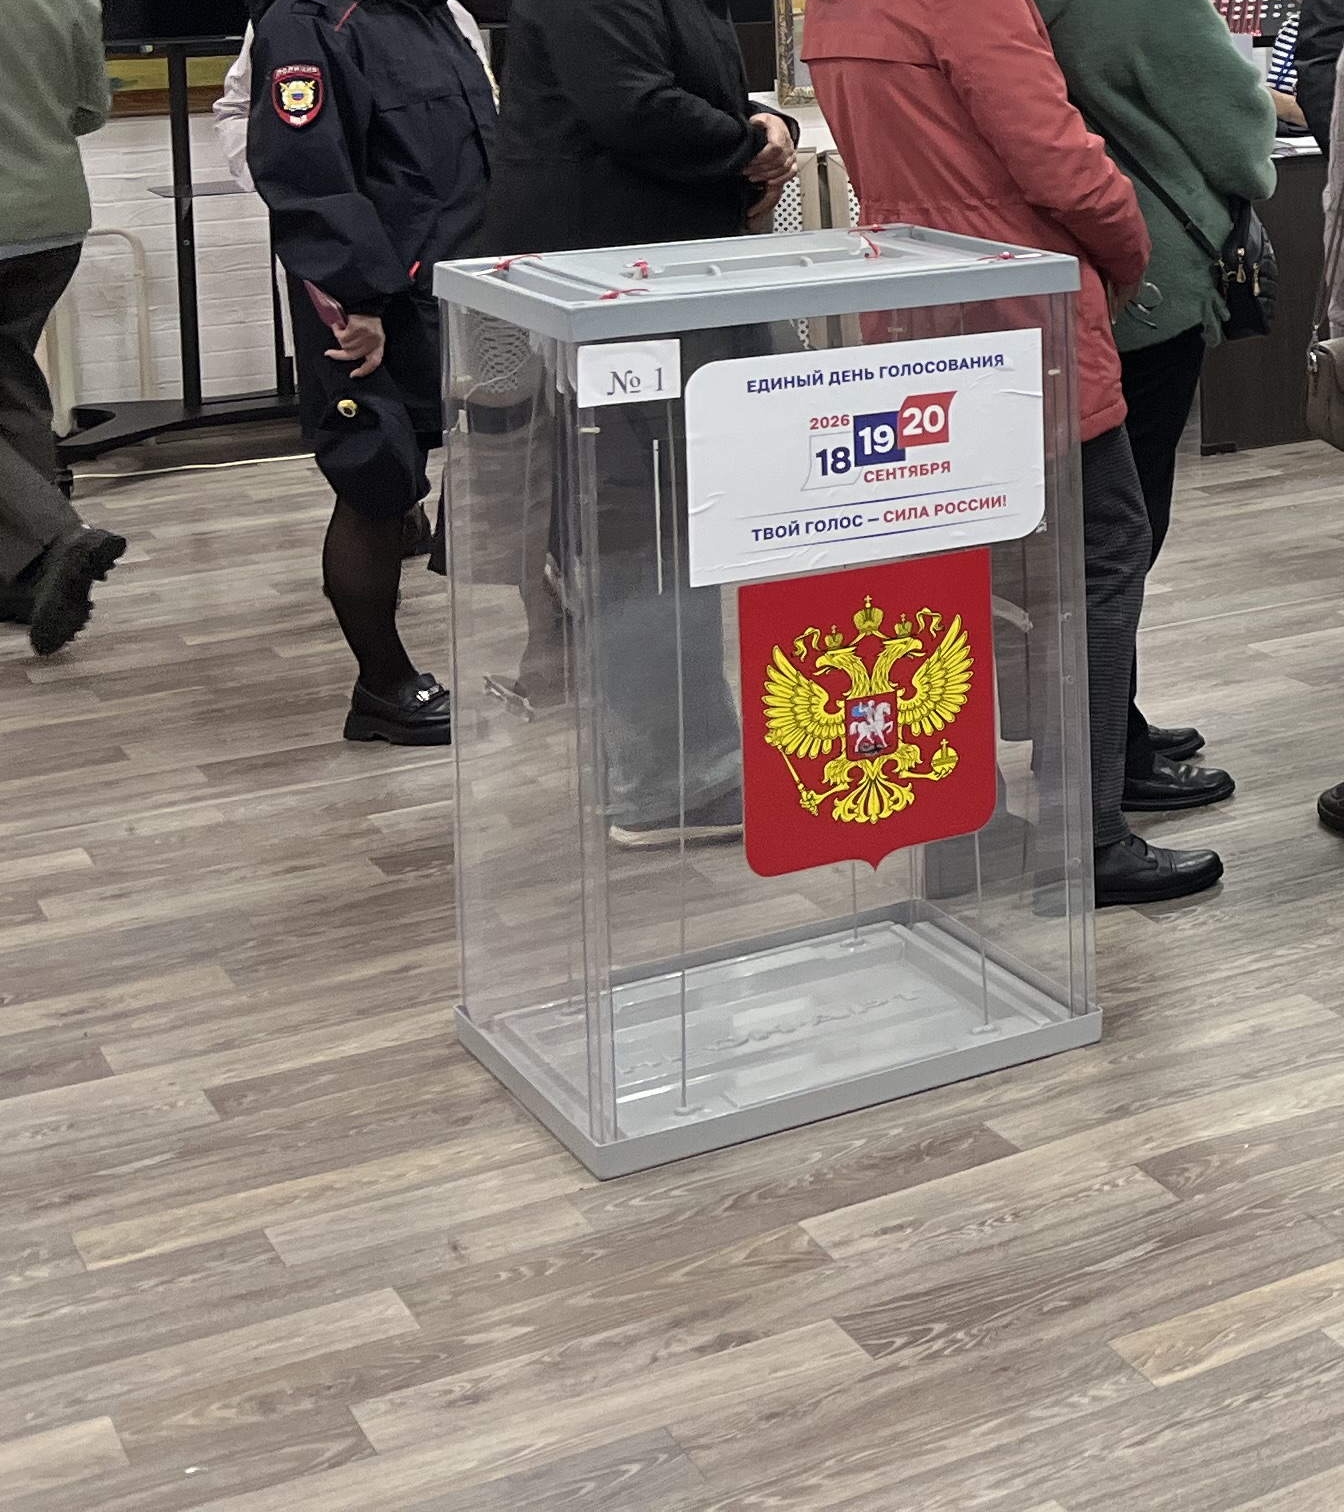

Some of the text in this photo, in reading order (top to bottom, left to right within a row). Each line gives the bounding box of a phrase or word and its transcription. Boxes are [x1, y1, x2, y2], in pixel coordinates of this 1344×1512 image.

[606, 367, 665, 396] № 1
[746, 354, 1005, 393] ЕДИНЫЙ ДЕНЬ ГОЛОСОВАНИЯ
[809, 413, 851, 430] 2026
[815, 404, 946, 476] 18 19 20
[863, 460, 951, 484] СЕНТЯБРЯ
[751, 520, 800, 542] ТВОЙ
[805, 514, 863, 535] ГОЛОС
[883, 505, 930, 524] СИЛА
[934, 494, 1008, 517] РОССИИ!
